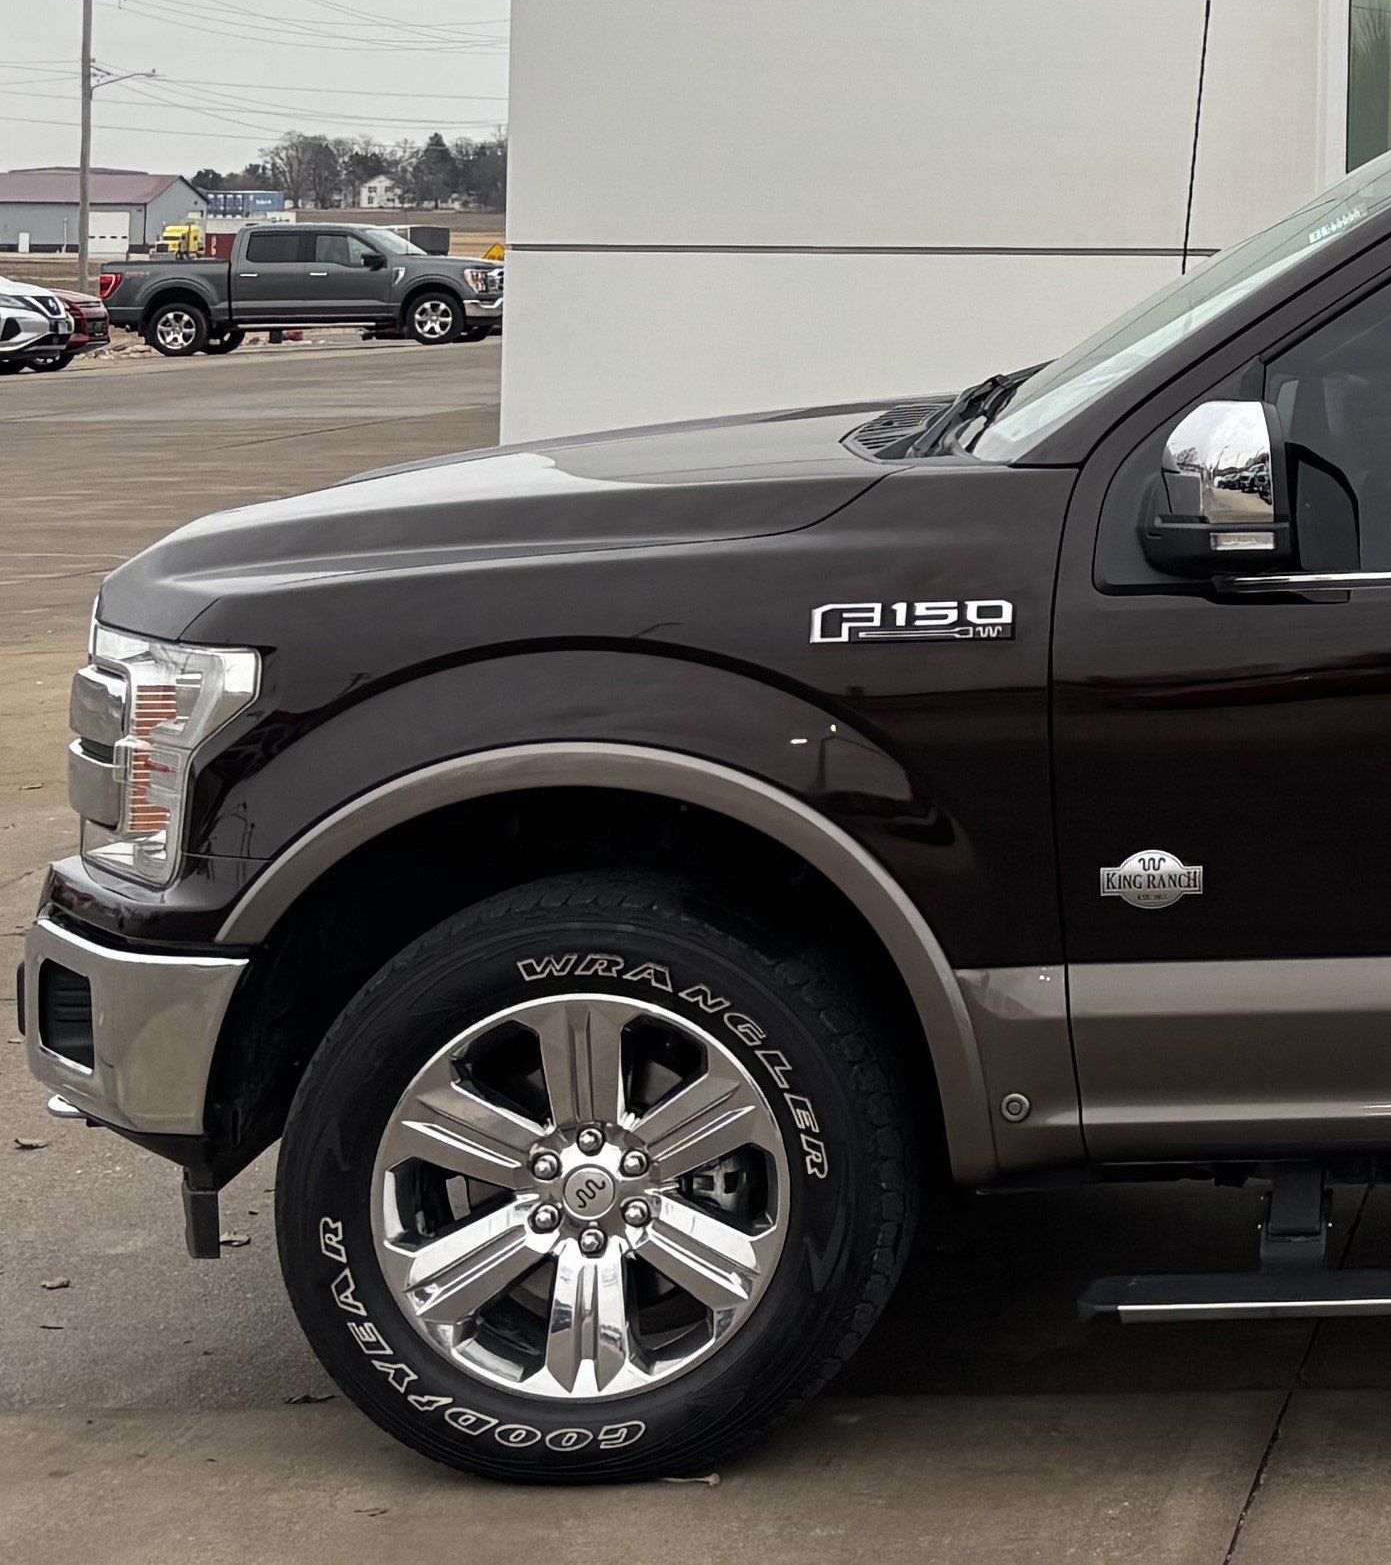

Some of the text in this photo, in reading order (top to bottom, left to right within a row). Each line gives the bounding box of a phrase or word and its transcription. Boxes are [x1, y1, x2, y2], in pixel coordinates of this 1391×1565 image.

[1106, 870, 1198, 890] KING RANCH
[517, 953, 828, 1180] WRANGLER
[320, 1217, 646, 1452] GOODYEAR
